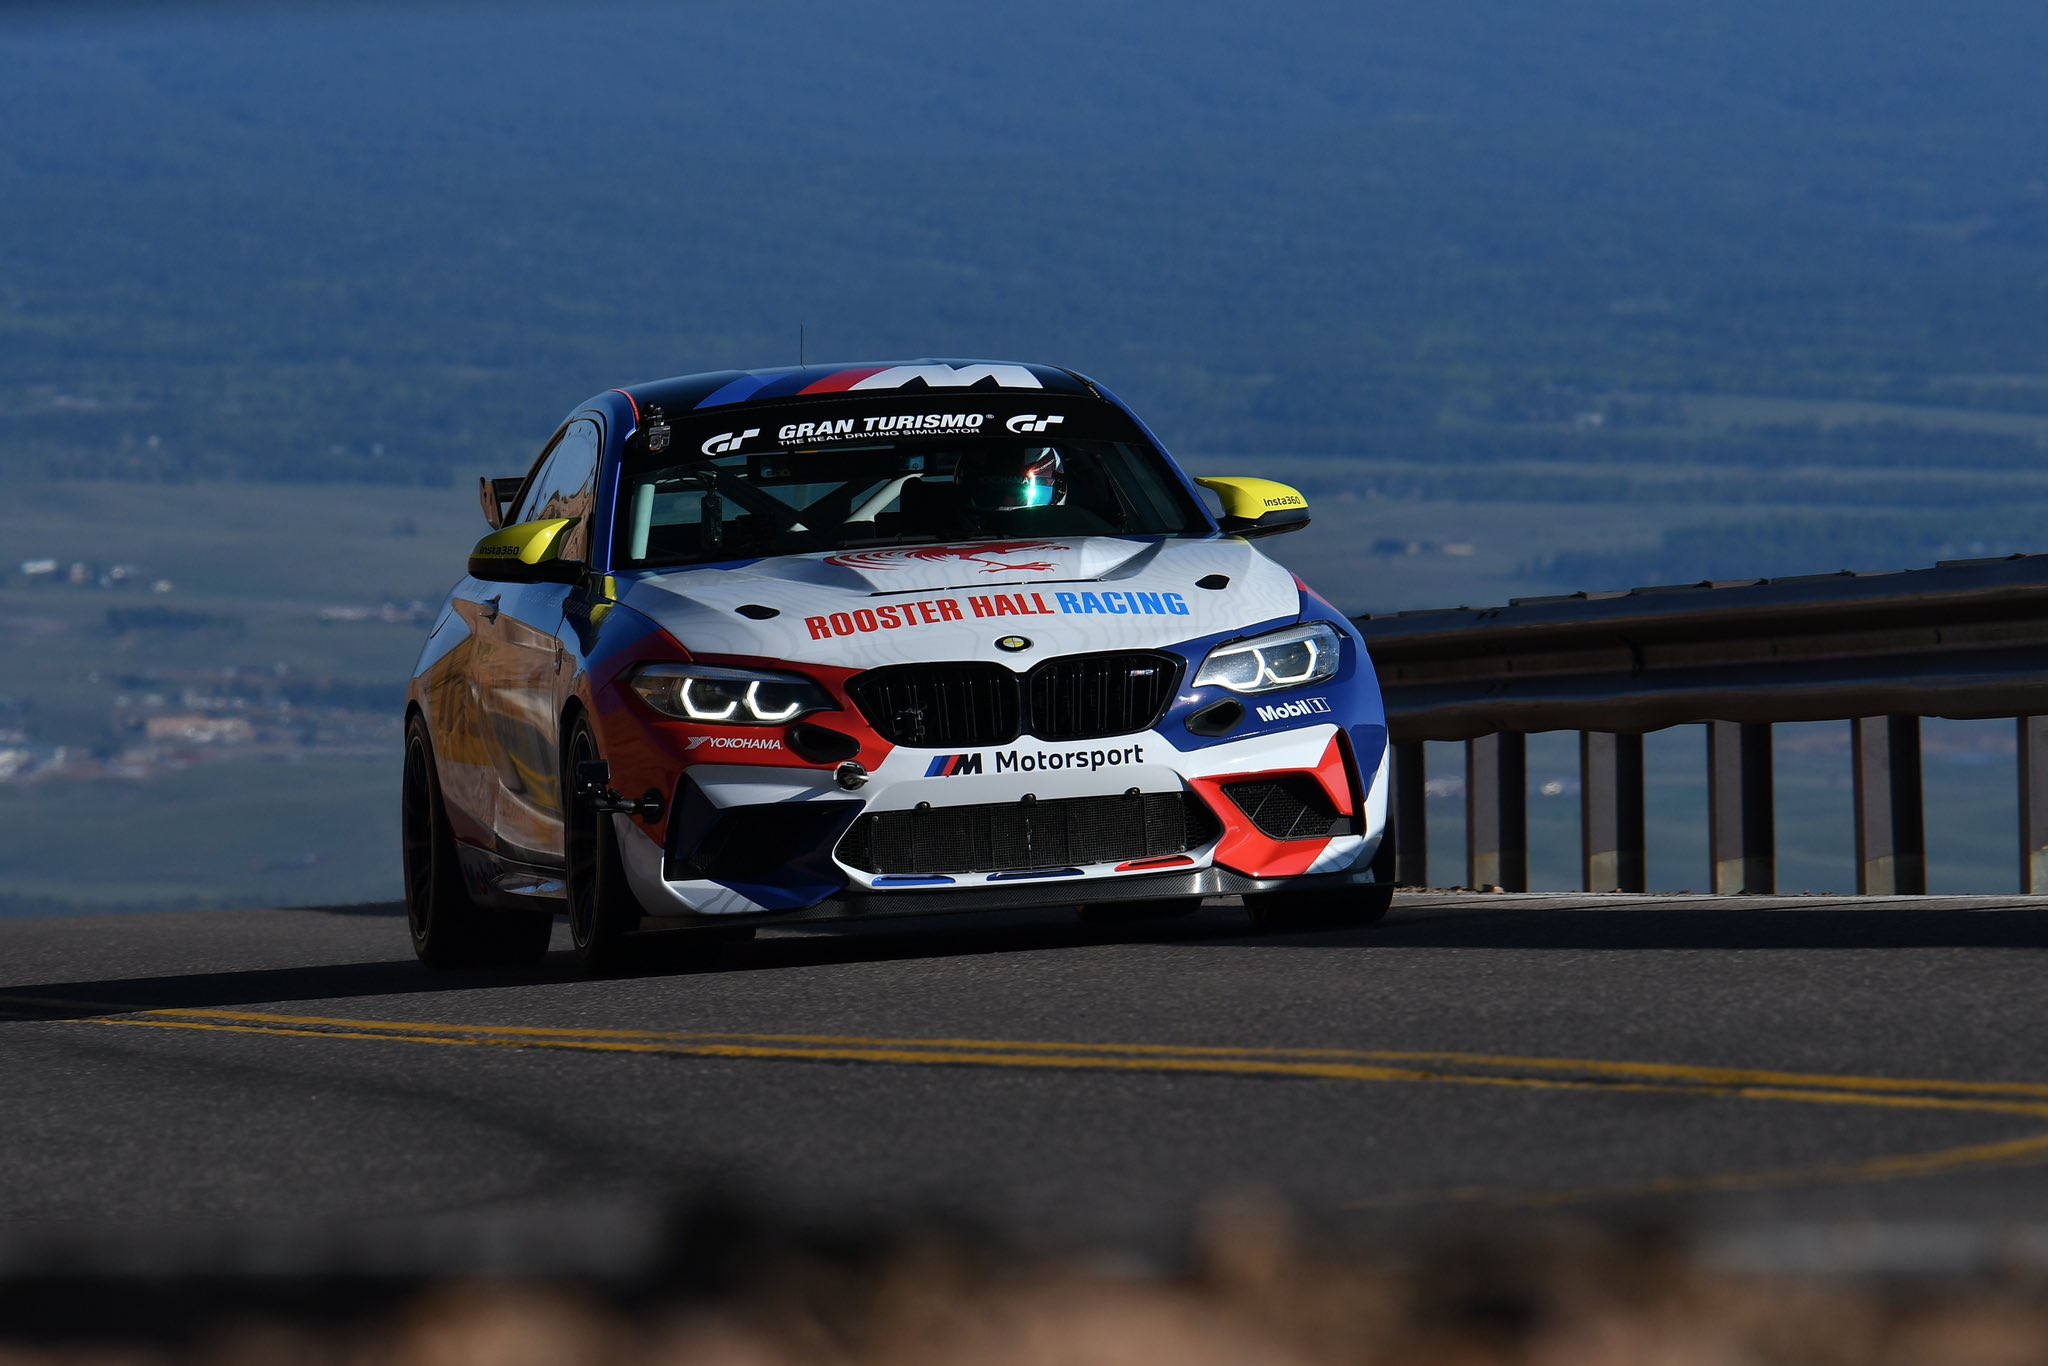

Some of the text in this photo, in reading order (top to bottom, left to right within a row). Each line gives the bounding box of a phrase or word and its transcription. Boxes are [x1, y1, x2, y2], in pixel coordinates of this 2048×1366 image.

[777, 428, 980, 446] THE REAL DRIVING SIMULATOR
[778, 418, 855, 440] GRAN
[1263, 495, 1301, 507] Insta360
[479, 545, 520, 556] Insta360
[804, 592, 1190, 641] ROOSTER HALL RACING
[709, 737, 783, 750] YOKOHAMA
[995, 744, 1144, 772] Motorsport
